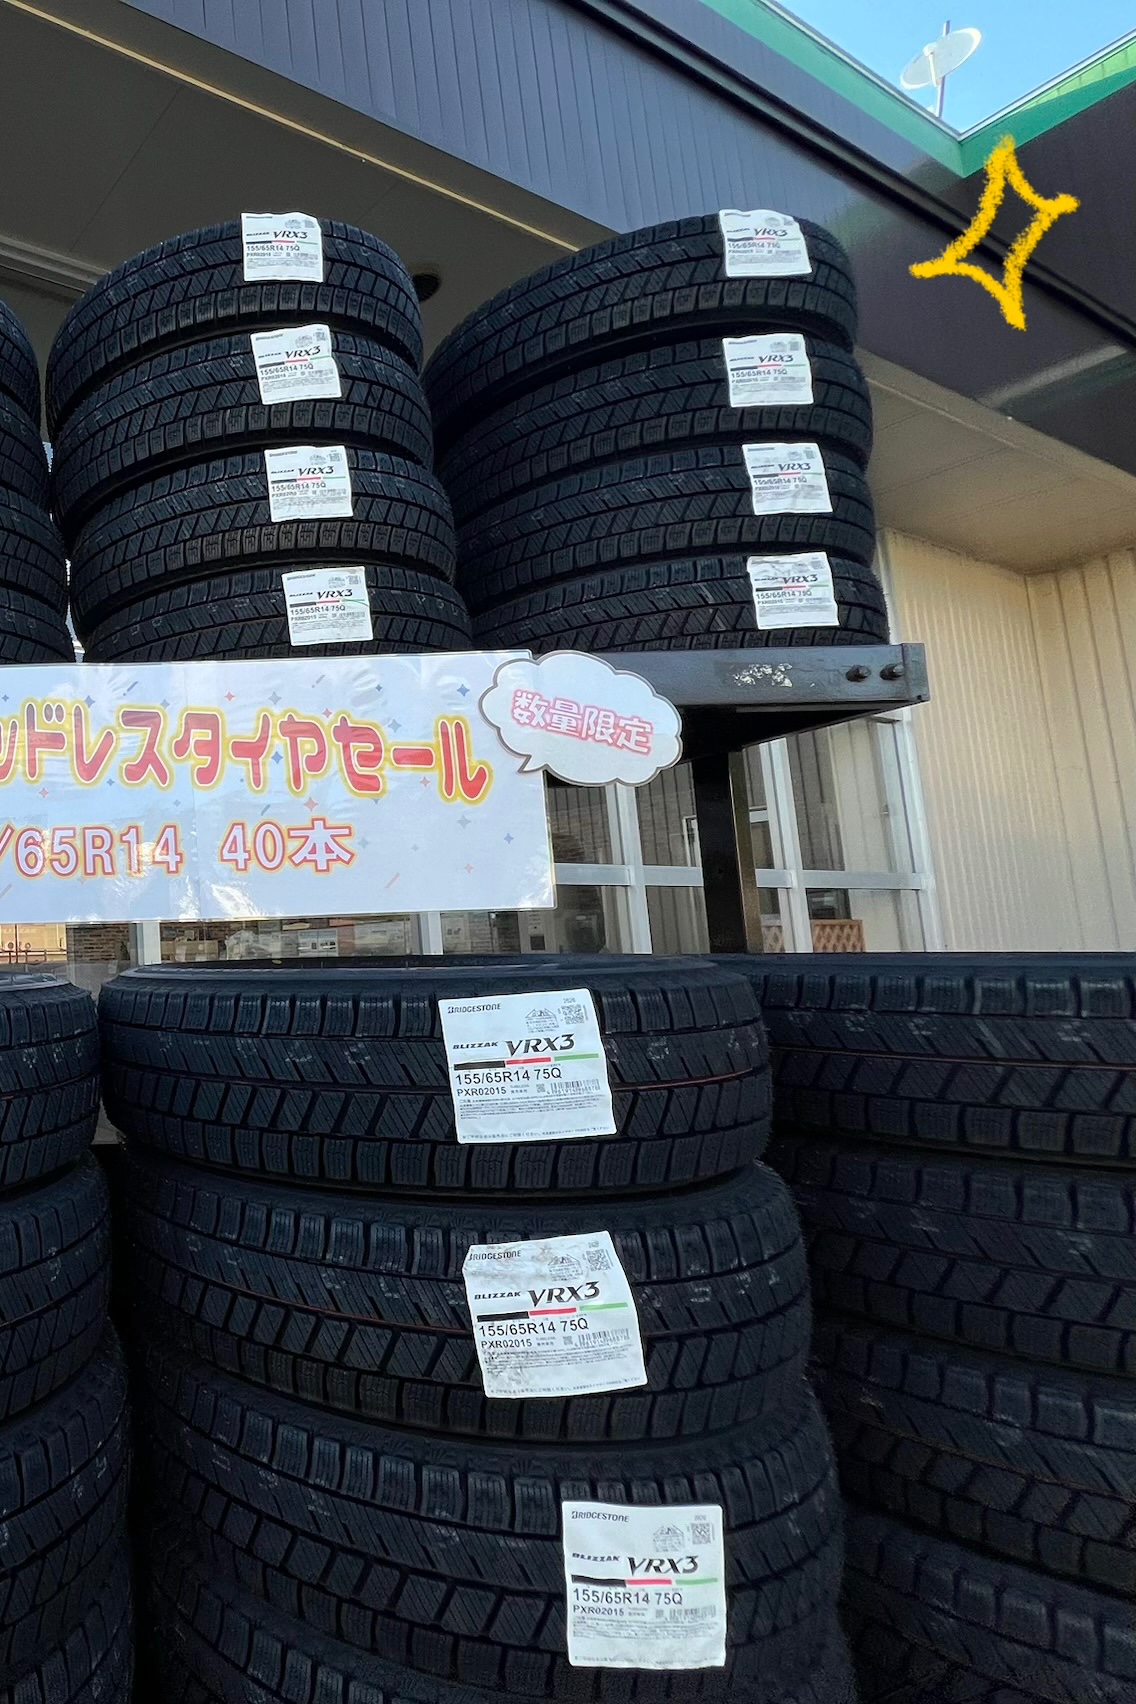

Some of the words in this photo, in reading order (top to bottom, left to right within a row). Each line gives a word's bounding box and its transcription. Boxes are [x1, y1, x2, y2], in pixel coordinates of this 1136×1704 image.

[273, 230, 308, 239] VRX3
[754, 228, 788, 237] VRX3
[246, 244, 284, 252] 155/65R14
[285, 345, 321, 358] VRX3
[758, 354, 794, 363] VRX3
[260, 365, 298, 376] 155/65R14
[731, 369, 771, 378] 155/65R14
[298, 466, 334, 477] VRX3
[777, 462, 811, 472] VRX3
[271, 483, 310, 492] 155/65R14
[782, 574, 818, 584] VRX3
[316, 588, 353, 600] VRX3
[756, 591, 796, 599] 155/65R14
[290, 606, 329, 616] 155/65R14
[512, 690, 653, 756] 数量限定
[220, 818, 355, 873] 40本
[447, 1003, 502, 1014] BRIDGESTONE
[452, 1041, 499, 1050] BLIZZAK
[504, 1033, 575, 1057] VRX3
[455, 1069, 530, 1086] 155/65R14
[534, 1067, 562, 1080] 75Q
[456, 1087, 507, 1097] PXR02015
[474, 1291, 521, 1300] BLIZZAK
[527, 1280, 601, 1308] VRX3
[479, 1321, 557, 1338] 155/65R14
[560, 1318, 589, 1332] 75Q
[481, 1339, 532, 1349] PXR02015
[571, 1510, 630, 1523] BRIDGESTONE
[572, 1552, 621, 1563] BLIZZAK
[627, 1555, 699, 1576] VRX3
[573, 1588, 650, 1605] 155/65R14
[655, 1592, 683, 1606] 75Q
[573, 1605, 624, 1616] PXR02015
